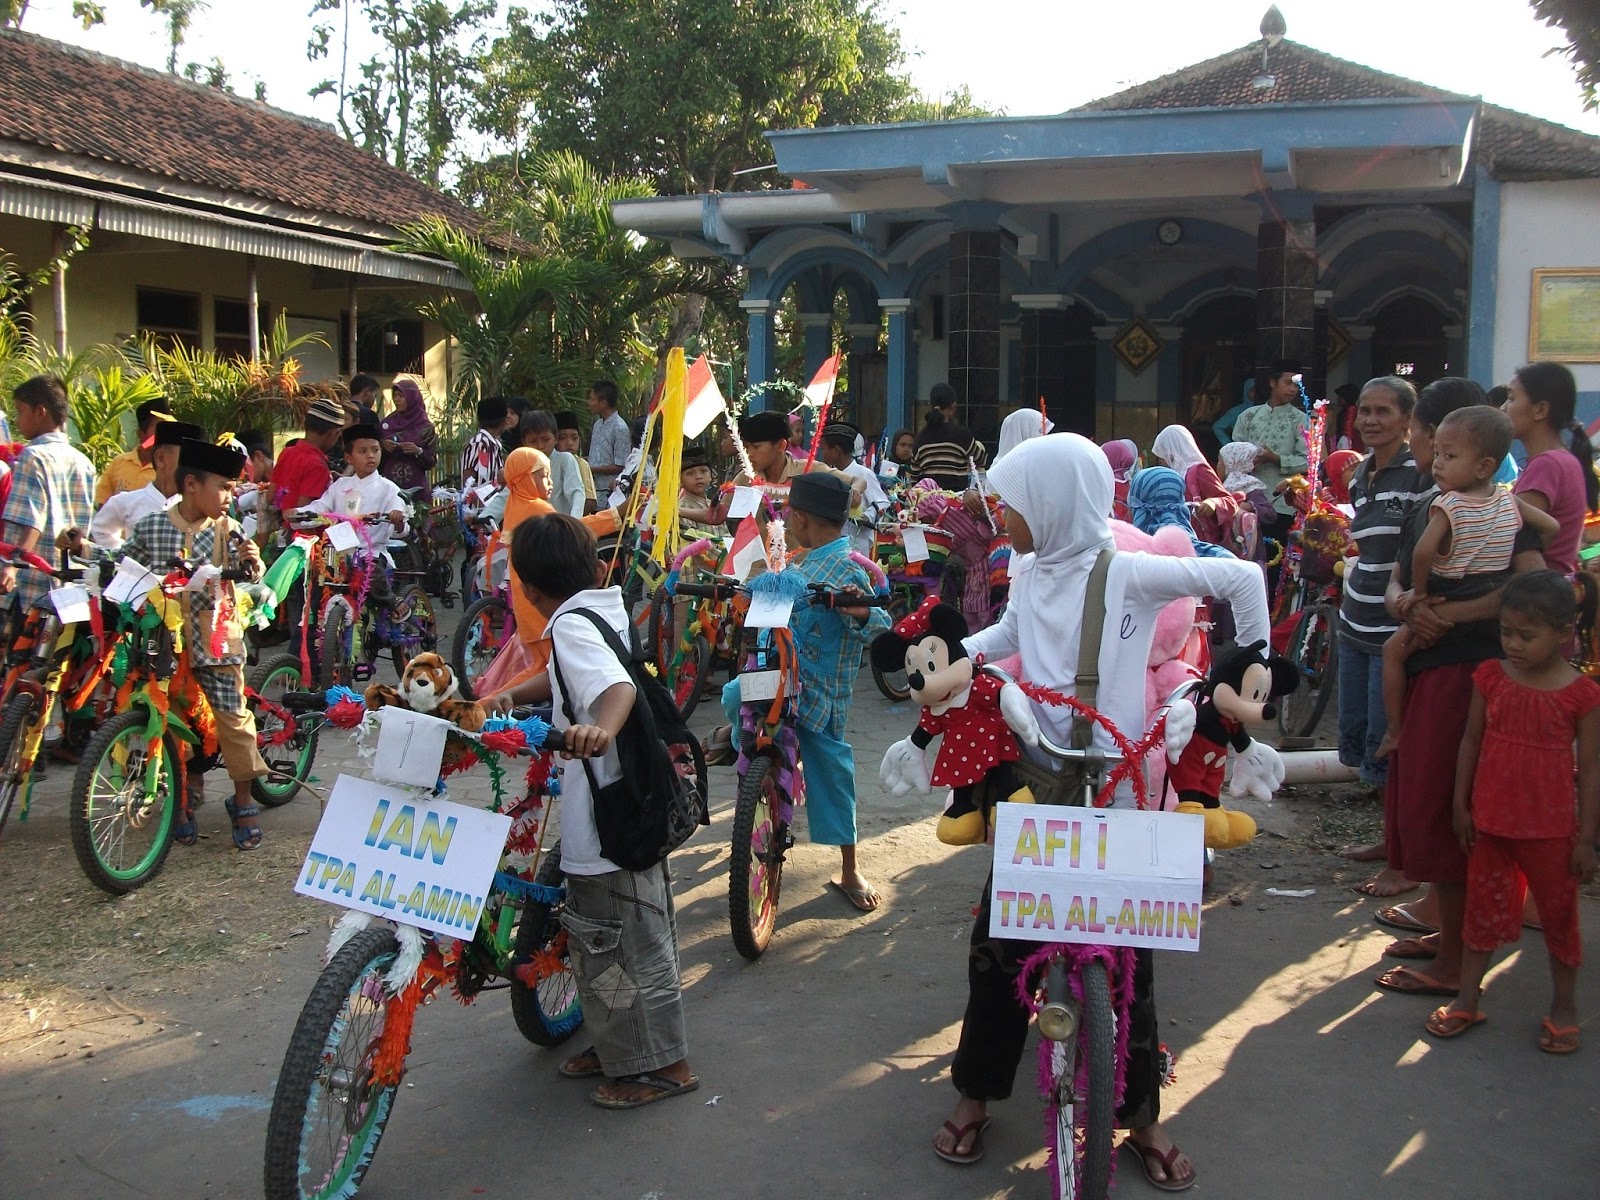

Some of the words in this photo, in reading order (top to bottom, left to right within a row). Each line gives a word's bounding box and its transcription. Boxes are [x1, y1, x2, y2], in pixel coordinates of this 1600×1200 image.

[364, 799, 458, 866] IAN
[304, 851, 357, 898] TPA
[359, 869, 482, 931] AL-AMIN
[996, 891, 1055, 930] TPA
[1064, 895, 1199, 940] AL-AMIN
